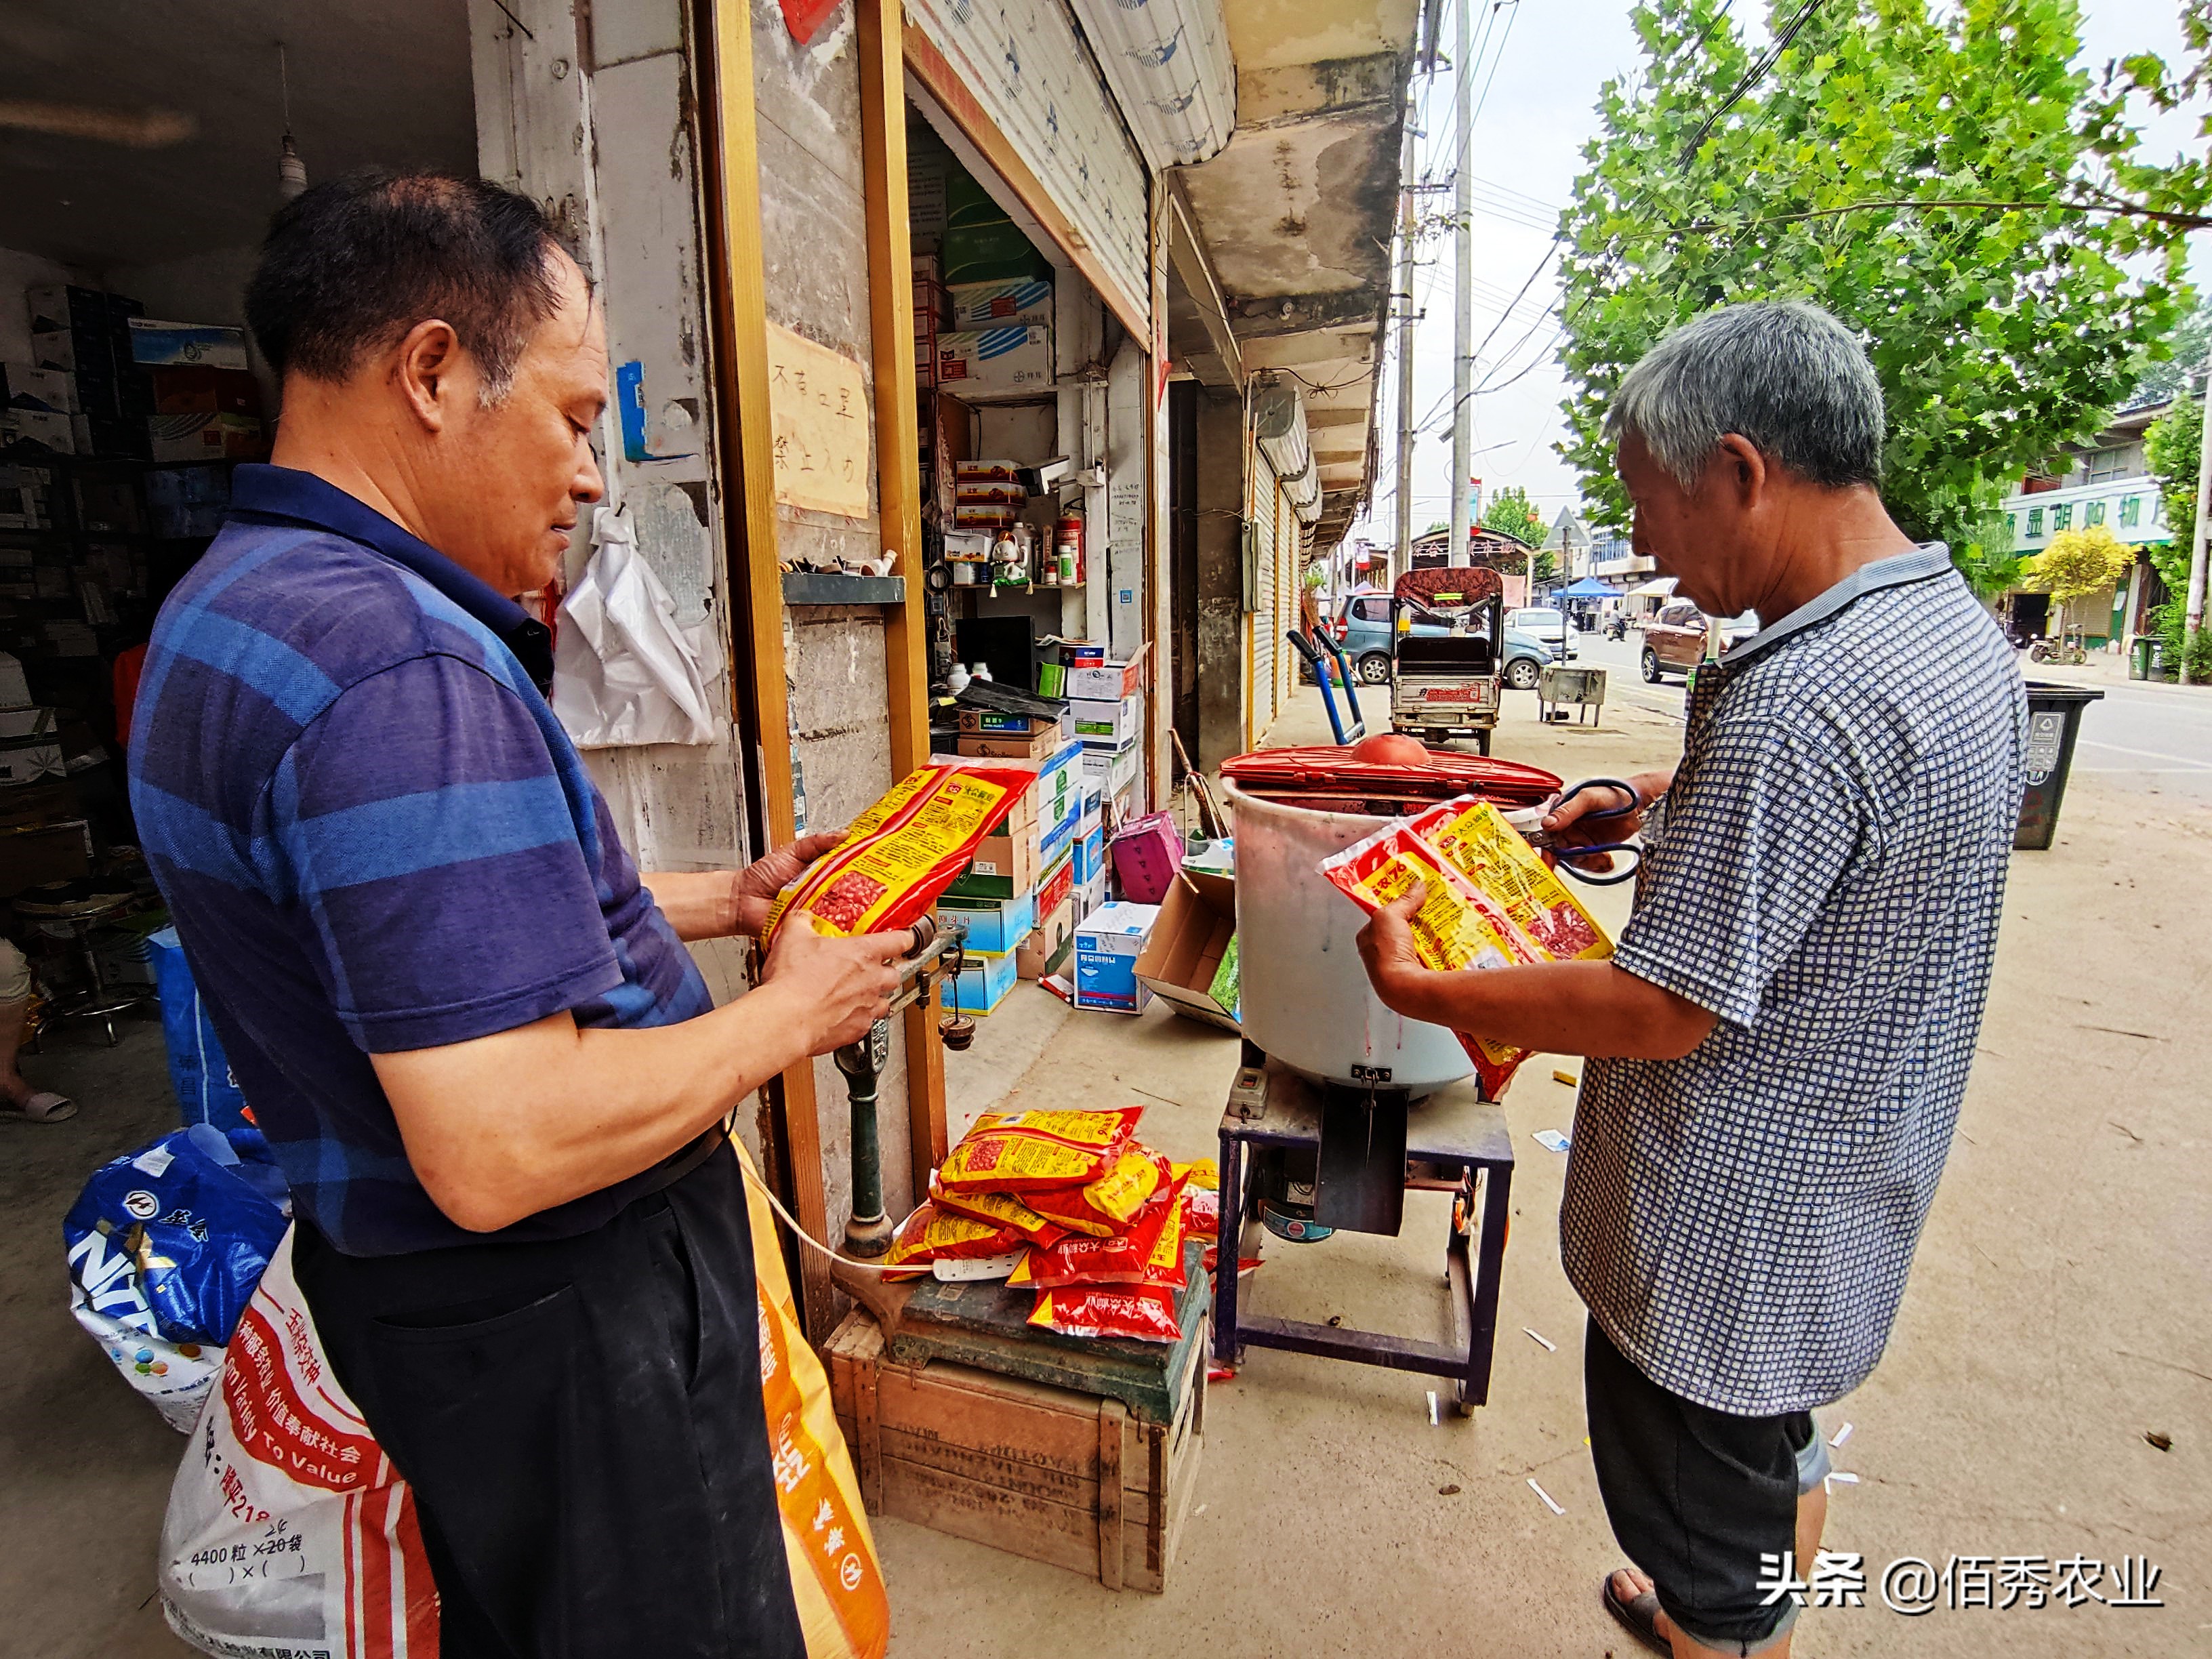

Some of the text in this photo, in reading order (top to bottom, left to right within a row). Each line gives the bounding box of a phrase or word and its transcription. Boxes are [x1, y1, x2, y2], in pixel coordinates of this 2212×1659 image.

[232, 1317, 361, 1464] 种服务农业 价值奉献社会
[284, 1307, 321, 1387] 玉米杂交种
[233, 1376, 258, 1442] Variety
[292, 1451, 357, 1484] Value
